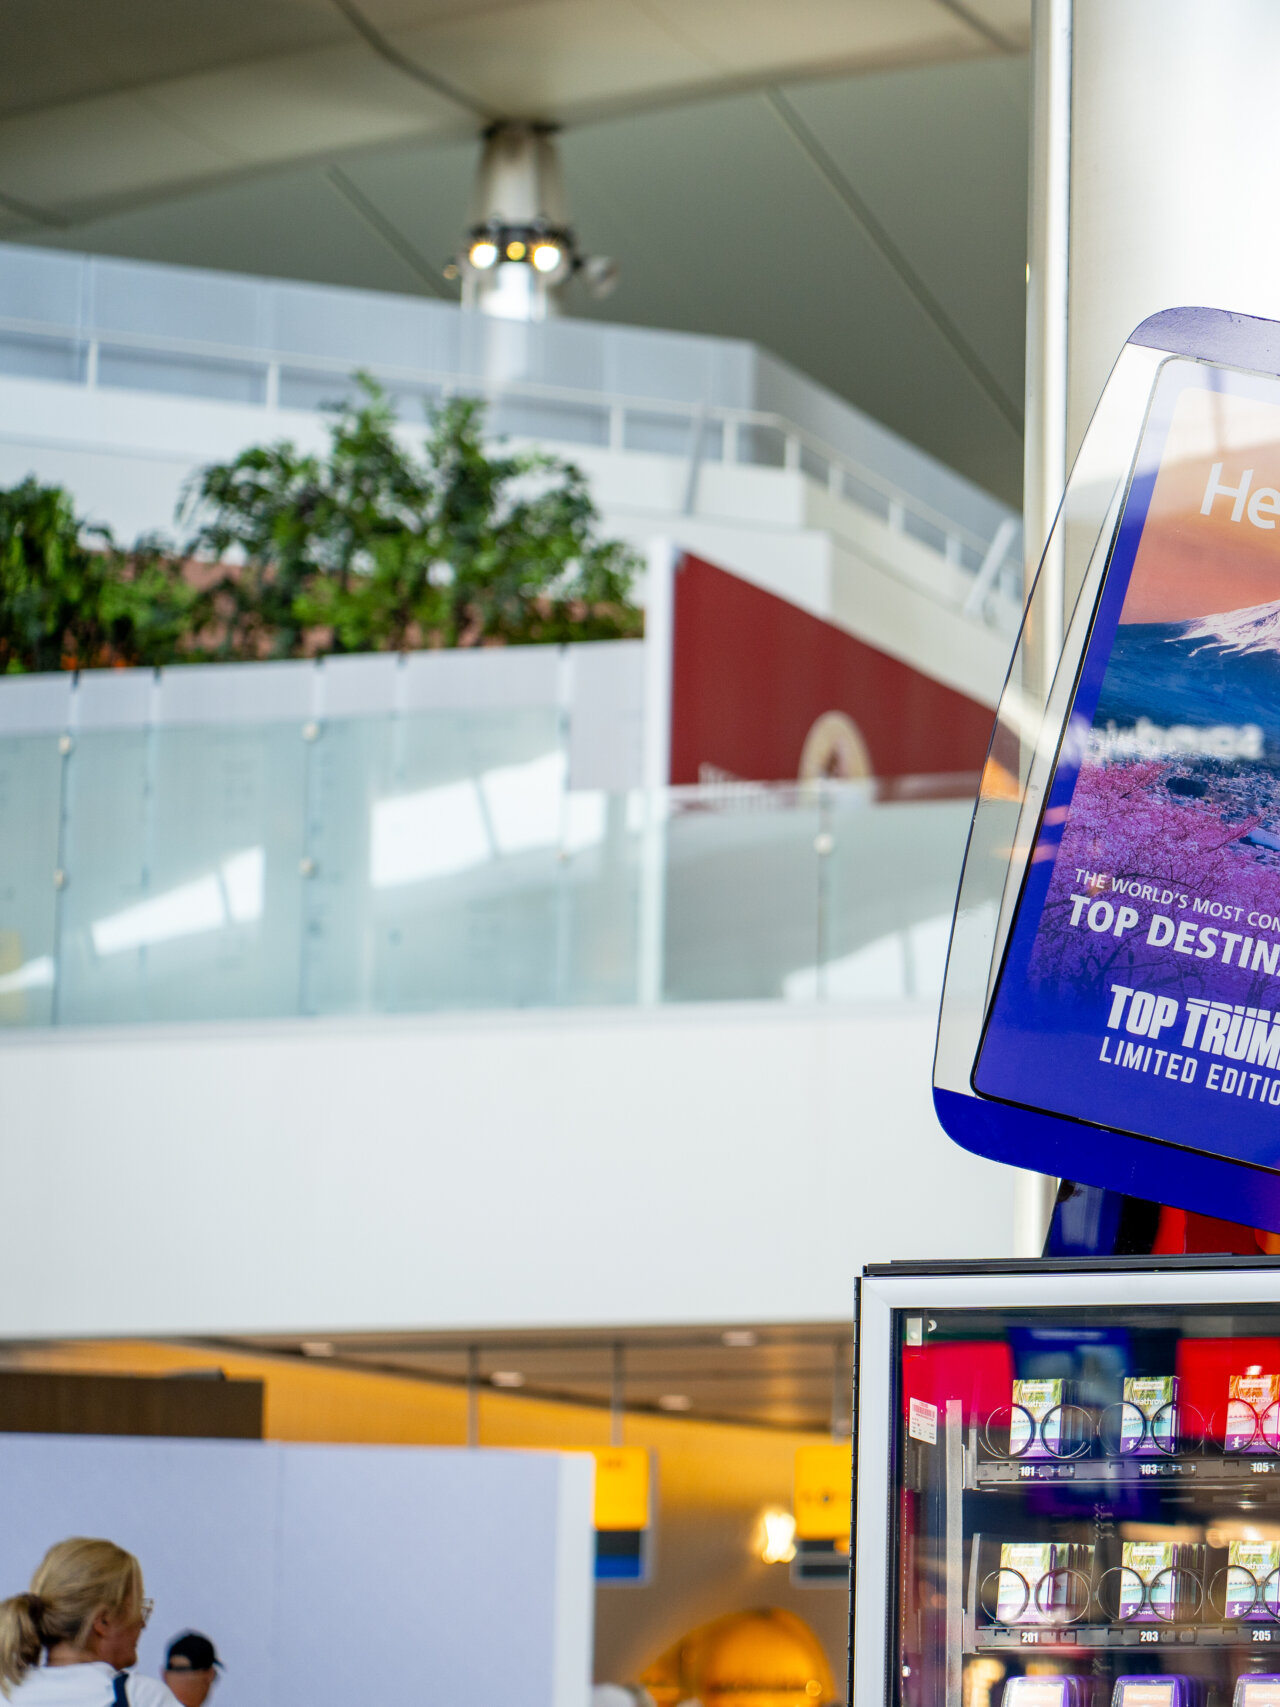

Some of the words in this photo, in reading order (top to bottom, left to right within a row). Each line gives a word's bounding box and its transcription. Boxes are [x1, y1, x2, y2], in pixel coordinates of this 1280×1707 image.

[1074, 868, 1108, 889] THE
[1111, 876, 1189, 910] WORLD'S
[1192, 897, 1245, 922] MOST
[1069, 893, 1139, 938] TOP
[1106, 984, 1179, 1040] TOP
[1099, 1036, 1198, 1084] LIMITED
[1129, 1397, 1168, 1406] Heathrow
[1020, 1465, 1035, 1477] 101
[1141, 1463, 1158, 1475] 103
[1251, 1462, 1269, 1473] 105
[1021, 1631, 1039, 1643] 201
[1140, 1630, 1159, 1642] 203
[1252, 1629, 1271, 1642] 205
